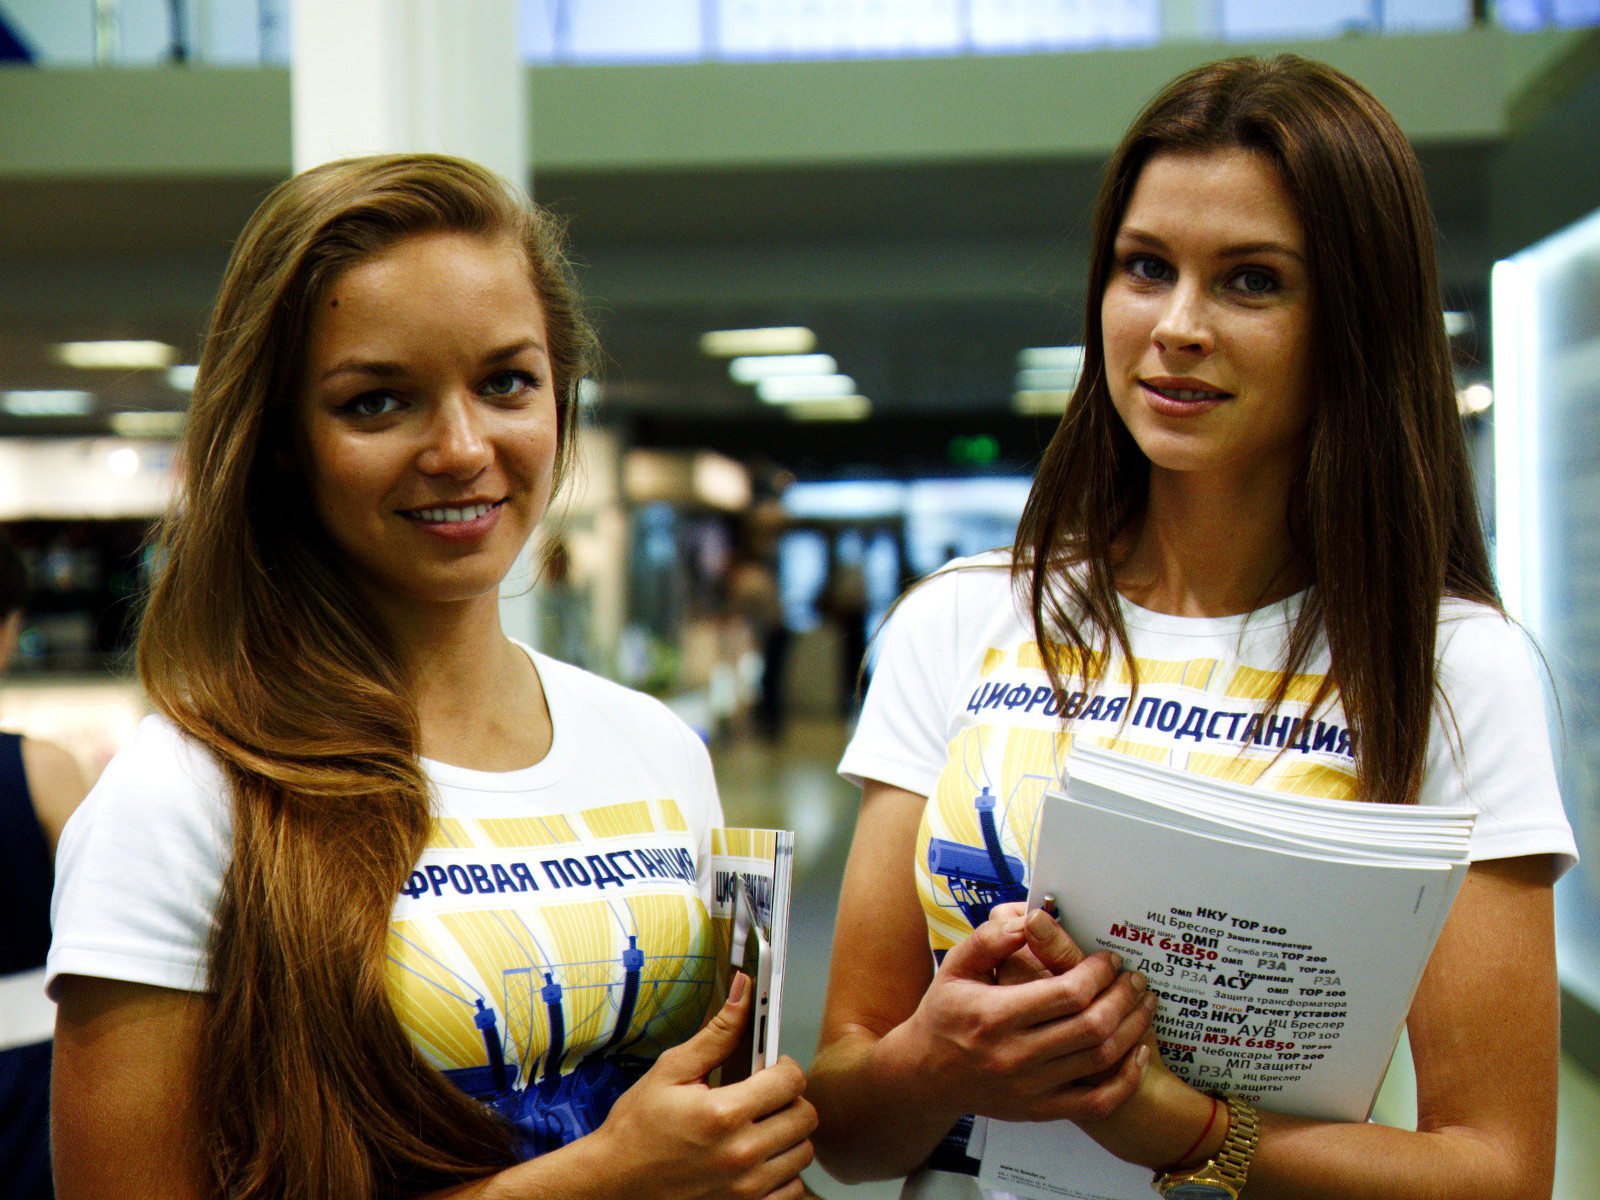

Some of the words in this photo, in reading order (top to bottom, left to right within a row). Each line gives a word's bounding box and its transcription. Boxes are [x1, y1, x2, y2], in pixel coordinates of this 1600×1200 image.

[966, 682, 1129, 722] ЦИФРОВАЯ
[1131, 696, 1354, 758] ПОДСТАНЦИЯ
[399, 862, 540, 900] ФРОВАЯ
[540, 847, 697, 890] ПОДСТАНЦИЯ
[1146, 910, 1166, 926] ИЦ
[1169, 916, 1225, 938] Бреслер
[1226, 932, 1260, 944] Защита
[1261, 939, 1313, 951] генератора
[1196, 906, 1228, 922] НКУ
[1262, 925, 1287, 935] 100
[1095, 937, 1144, 957] Чебоксары
[1109, 923, 1155, 946] МЭК
[1159, 937, 1219, 961] 61850
[1123, 920, 1155, 934] Защита
[1181, 932, 1219, 949] ОМП
[1226, 945, 1260, 957] Служба
[1305, 955, 1328, 963] 200
[1213, 974, 1254, 991] АСУ
[1237, 969, 1295, 984] Терминал
[1146, 984, 1209, 1010] реслер
[1245, 1004, 1291, 1017] Расчет
[1293, 1010, 1348, 1019] уставок
[1213, 990, 1254, 1003] Защита
[1256, 997, 1348, 1008] трансформатора
[1153, 1013, 1204, 1031] минал
[1237, 1024, 1276, 1038] АУВ
[1319, 1032, 1340, 1040] 100
[1210, 1010, 1249, 1025] НКУ
[1268, 1019, 1287, 1029] ИЦ
[1290, 1020, 1345, 1030] Бреслер
[1153, 1023, 1201, 1041] иний
[1202, 1032, 1242, 1047] МЭК
[1245, 1037, 1296, 1051] 61850
[1201, 1045, 1273, 1061] Чебоксары
[1165, 1063, 1190, 1075] 00
[1242, 1073, 1258, 1081] ИЦ
[1260, 1074, 1301, 1082] Бреслер
[1225, 1058, 1251, 1069] МП
[1254, 1062, 1313, 1072] защиты
[1192, 1078, 1231, 1091] Шкаф
[1233, 1084, 1283, 1092] защиты
